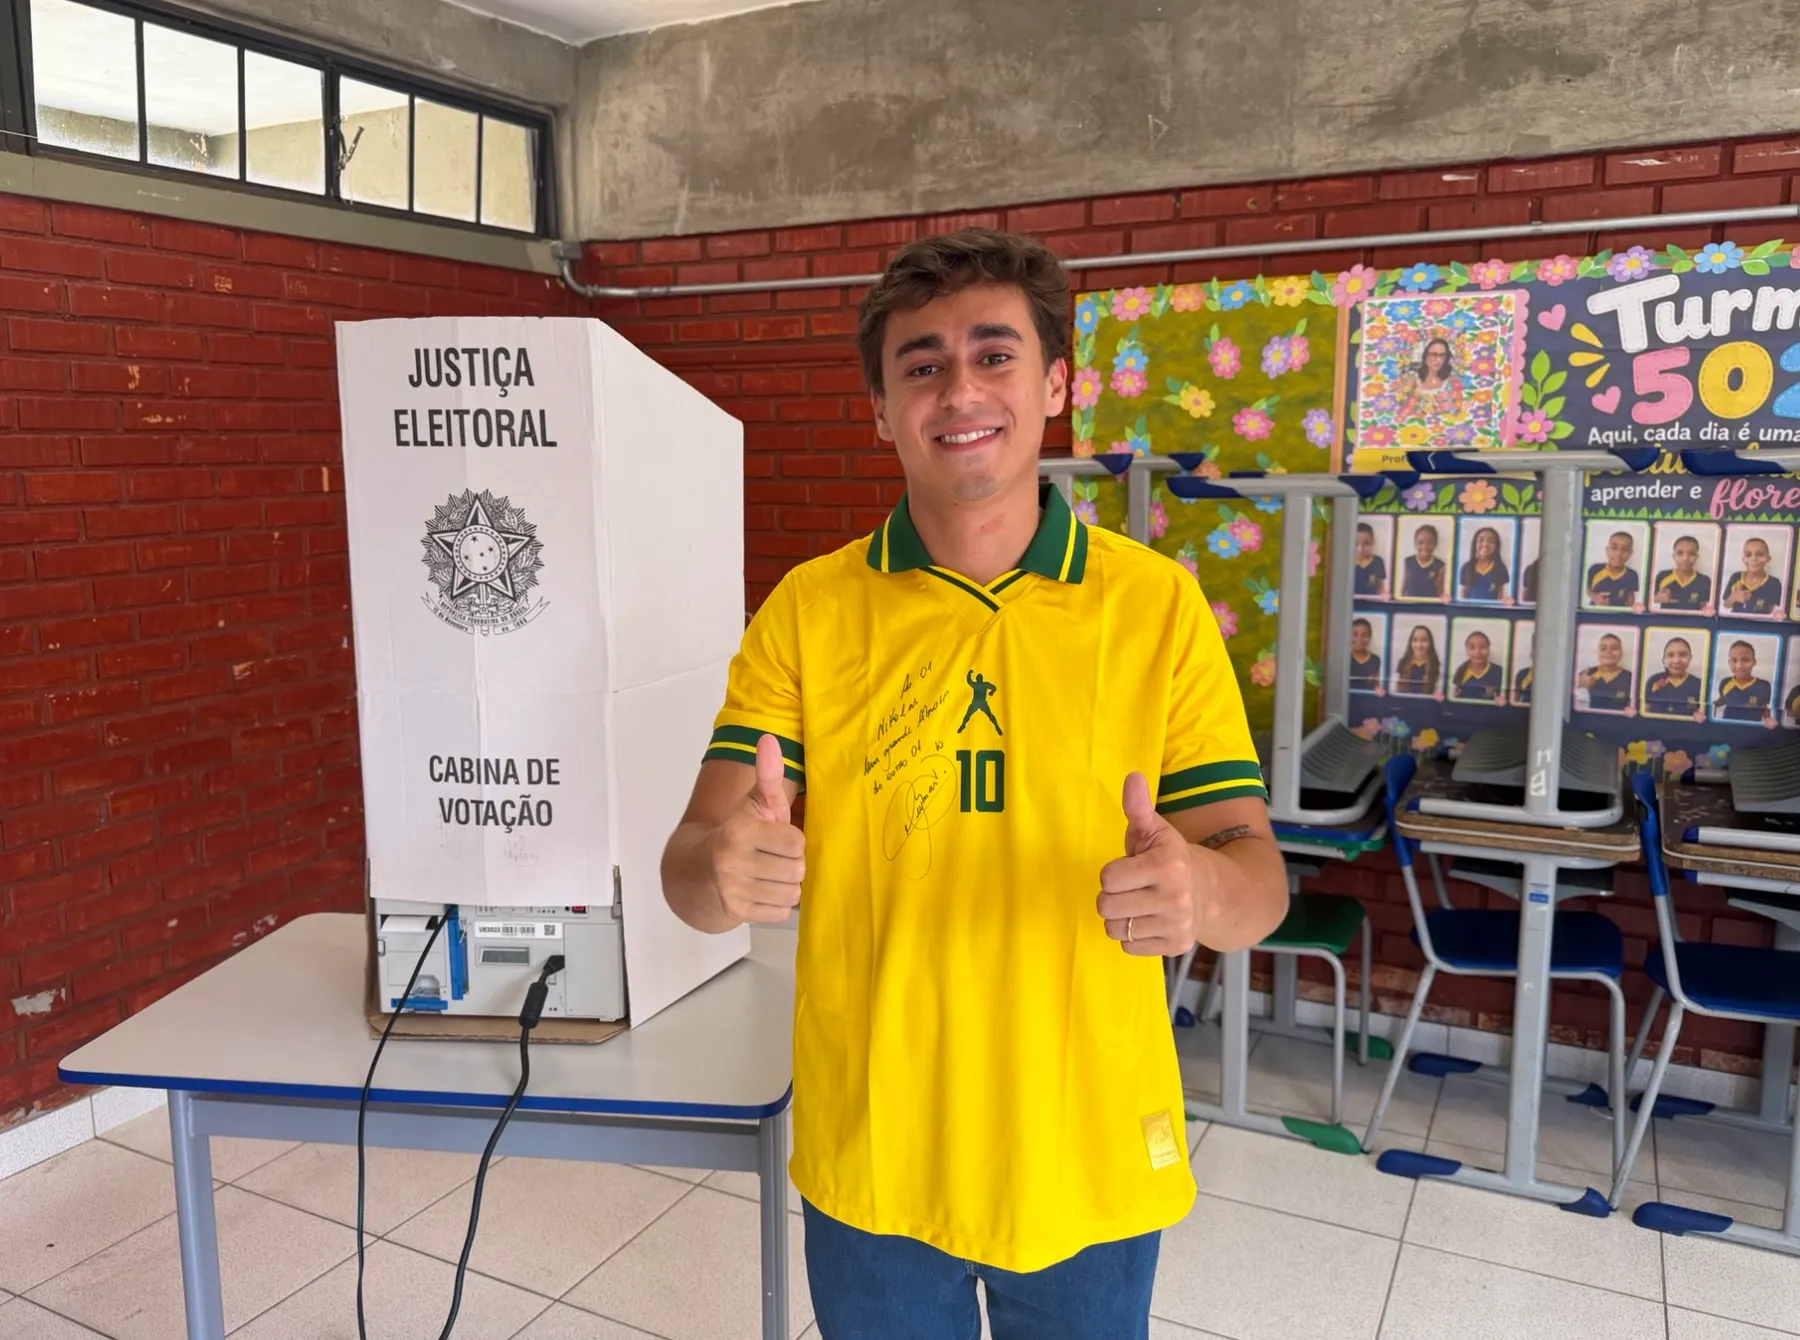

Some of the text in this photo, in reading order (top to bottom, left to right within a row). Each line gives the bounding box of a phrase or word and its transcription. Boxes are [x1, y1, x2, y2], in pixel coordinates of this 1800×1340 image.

[408, 346, 535, 398] JUSTIÇA
[394, 408, 557, 448] ELEITORAL
[1588, 425, 1638, 448] Aqui,
[1644, 421, 1691, 441] cada
[1699, 421, 1729, 441] dia
[1738, 422, 1750, 440] é
[1591, 479, 1682, 505] aprender
[1690, 486, 1702, 499] e
[429, 755, 560, 786] CABINA DE
[956, 750, 1005, 813] 10
[439, 794, 553, 833] VOTAÇÃO
